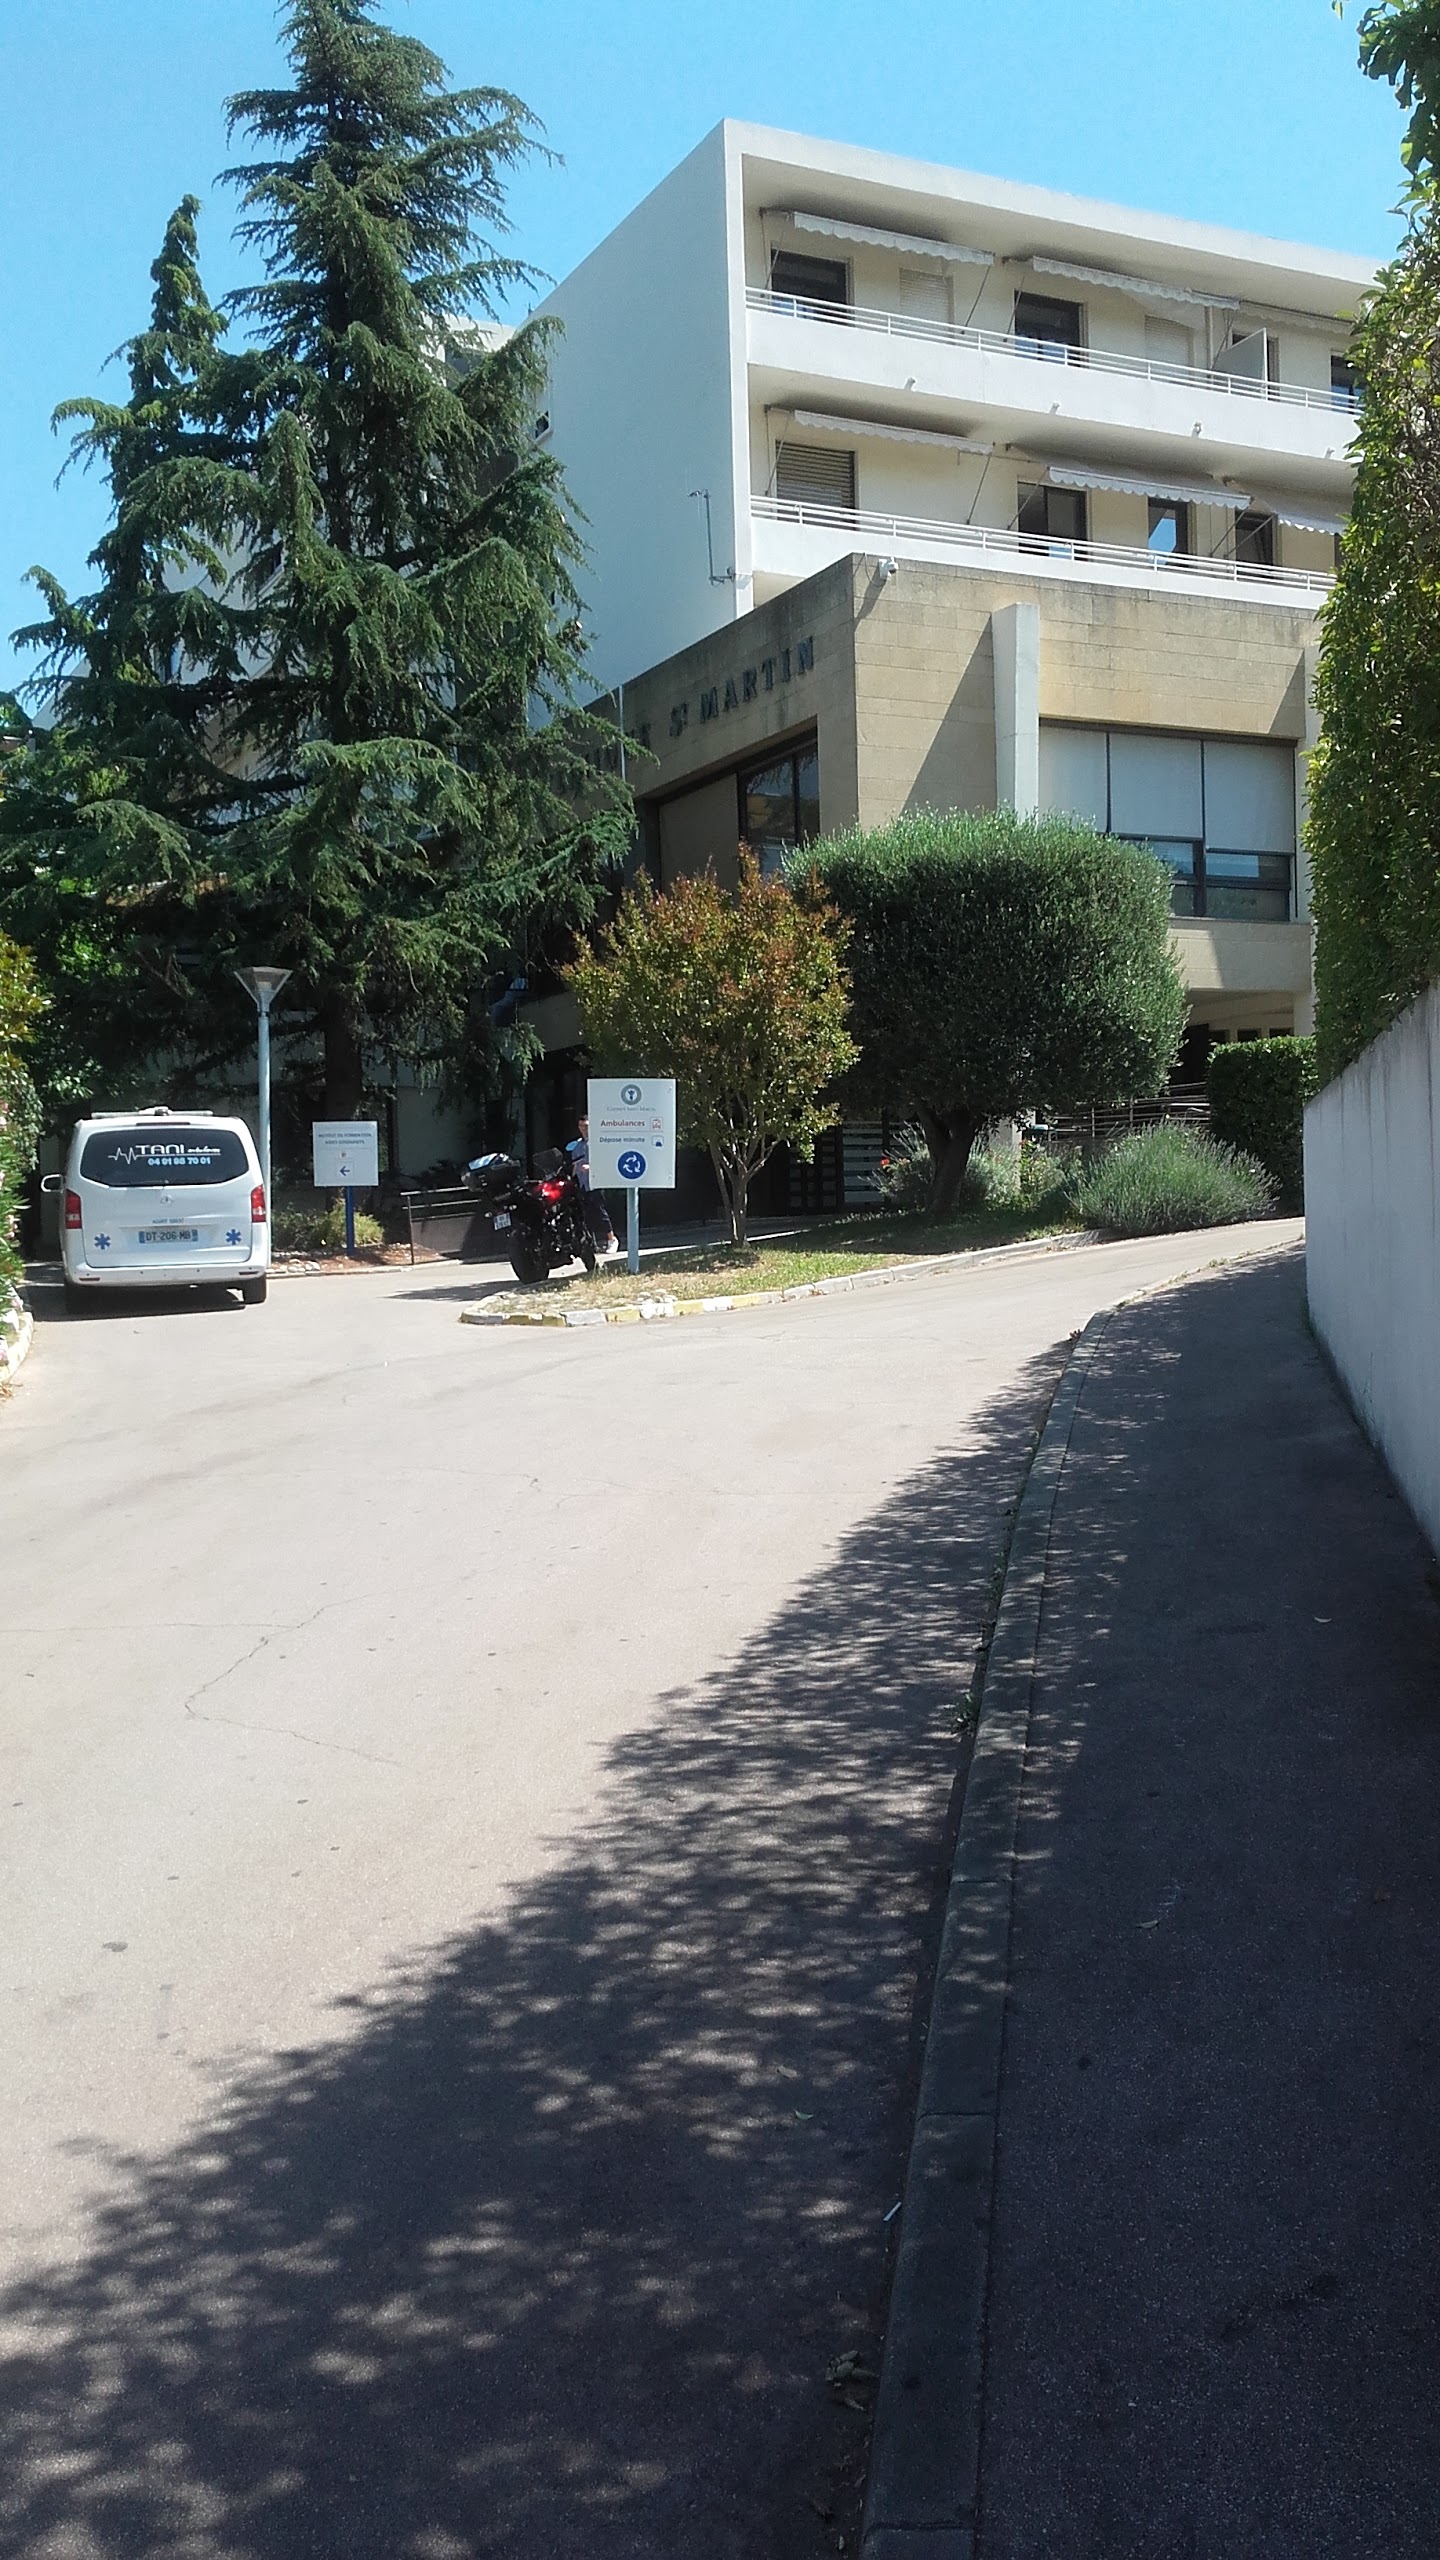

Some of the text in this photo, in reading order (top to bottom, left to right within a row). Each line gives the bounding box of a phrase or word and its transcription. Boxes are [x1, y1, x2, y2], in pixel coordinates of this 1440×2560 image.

[699, 635, 814, 724] MARTIN
[600, 1119, 646, 1127] Ambulances
[599, 1136, 622, 1144] Dépose
[135, 1144, 185, 1155] TANI
[147, 1157, 161, 1166] 04
[186, 1156, 199, 1165] 70
[200, 1156, 211, 1165] 01
